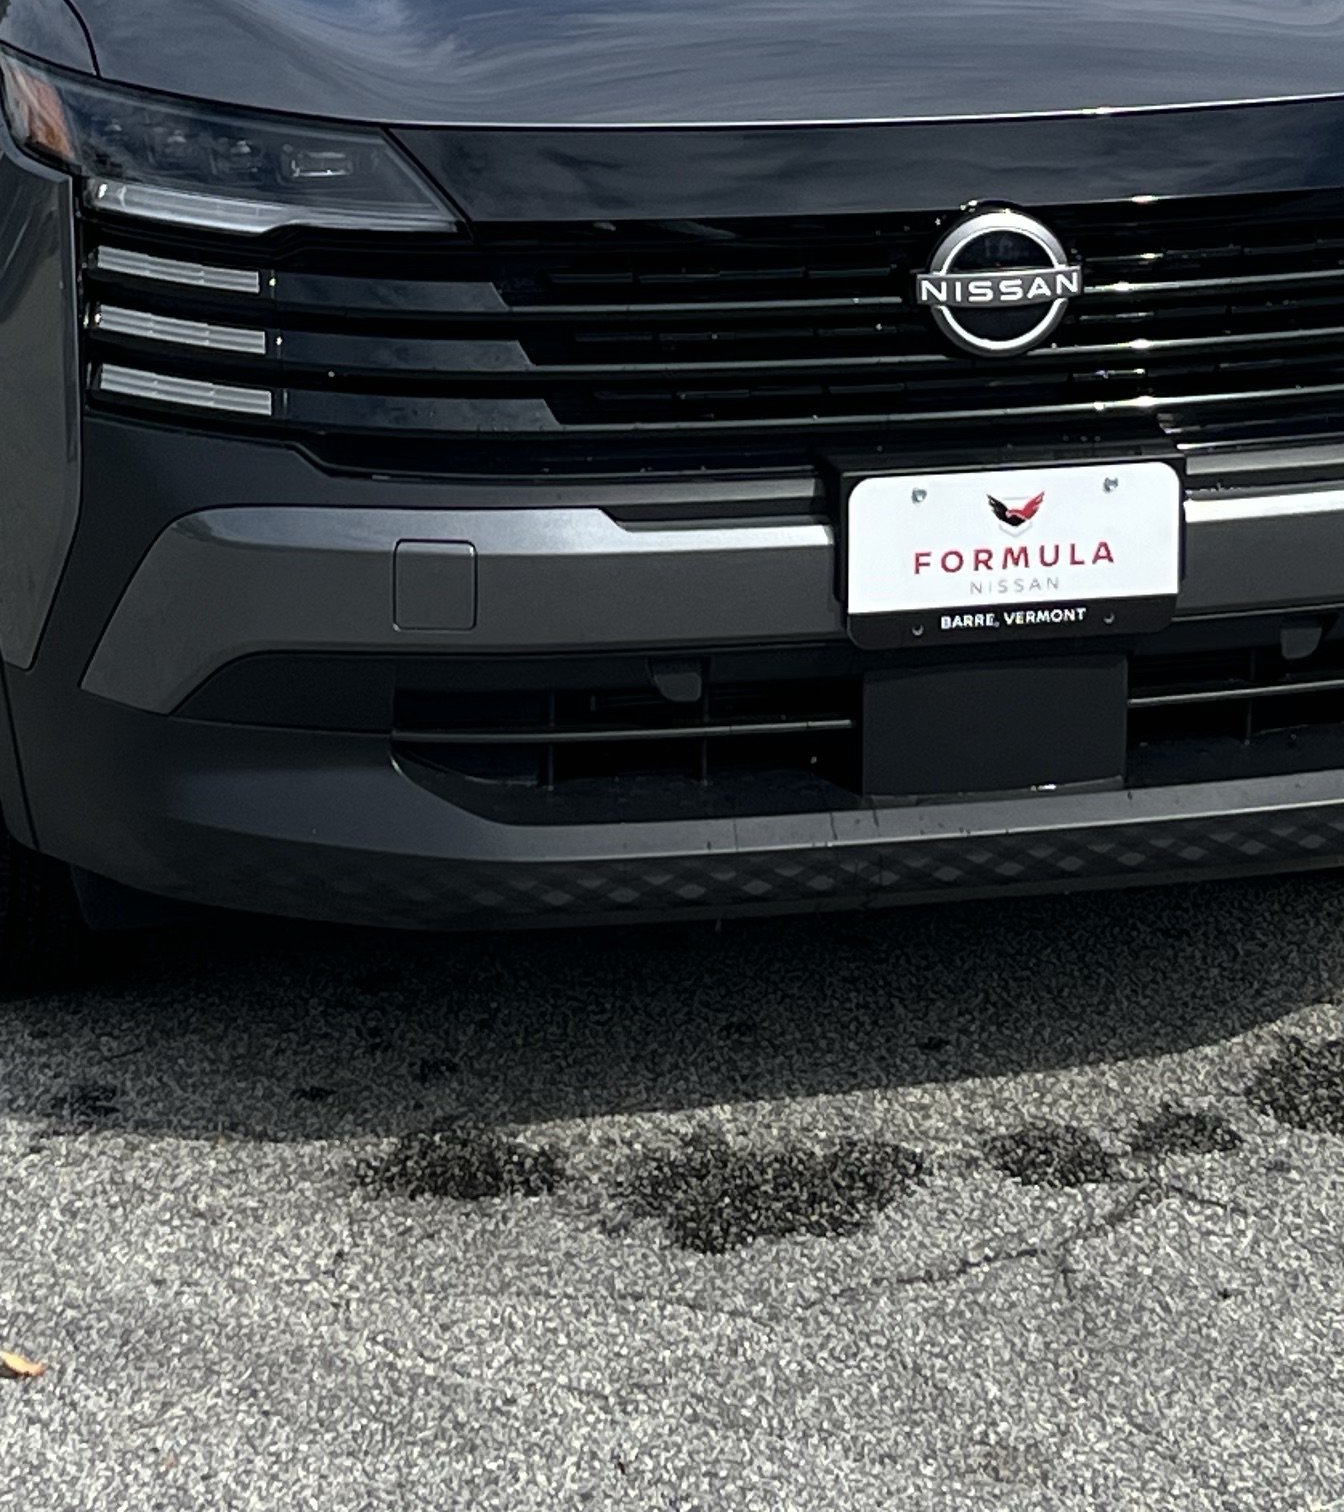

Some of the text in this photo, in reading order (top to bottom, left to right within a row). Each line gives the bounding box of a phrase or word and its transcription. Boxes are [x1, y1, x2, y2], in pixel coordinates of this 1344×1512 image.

[920, 271, 1079, 303] NISSAN
[913, 540, 1115, 575] FORMULA
[969, 575, 1060, 595] NISSAN
[940, 607, 1087, 630] BARRE, VERMONT
